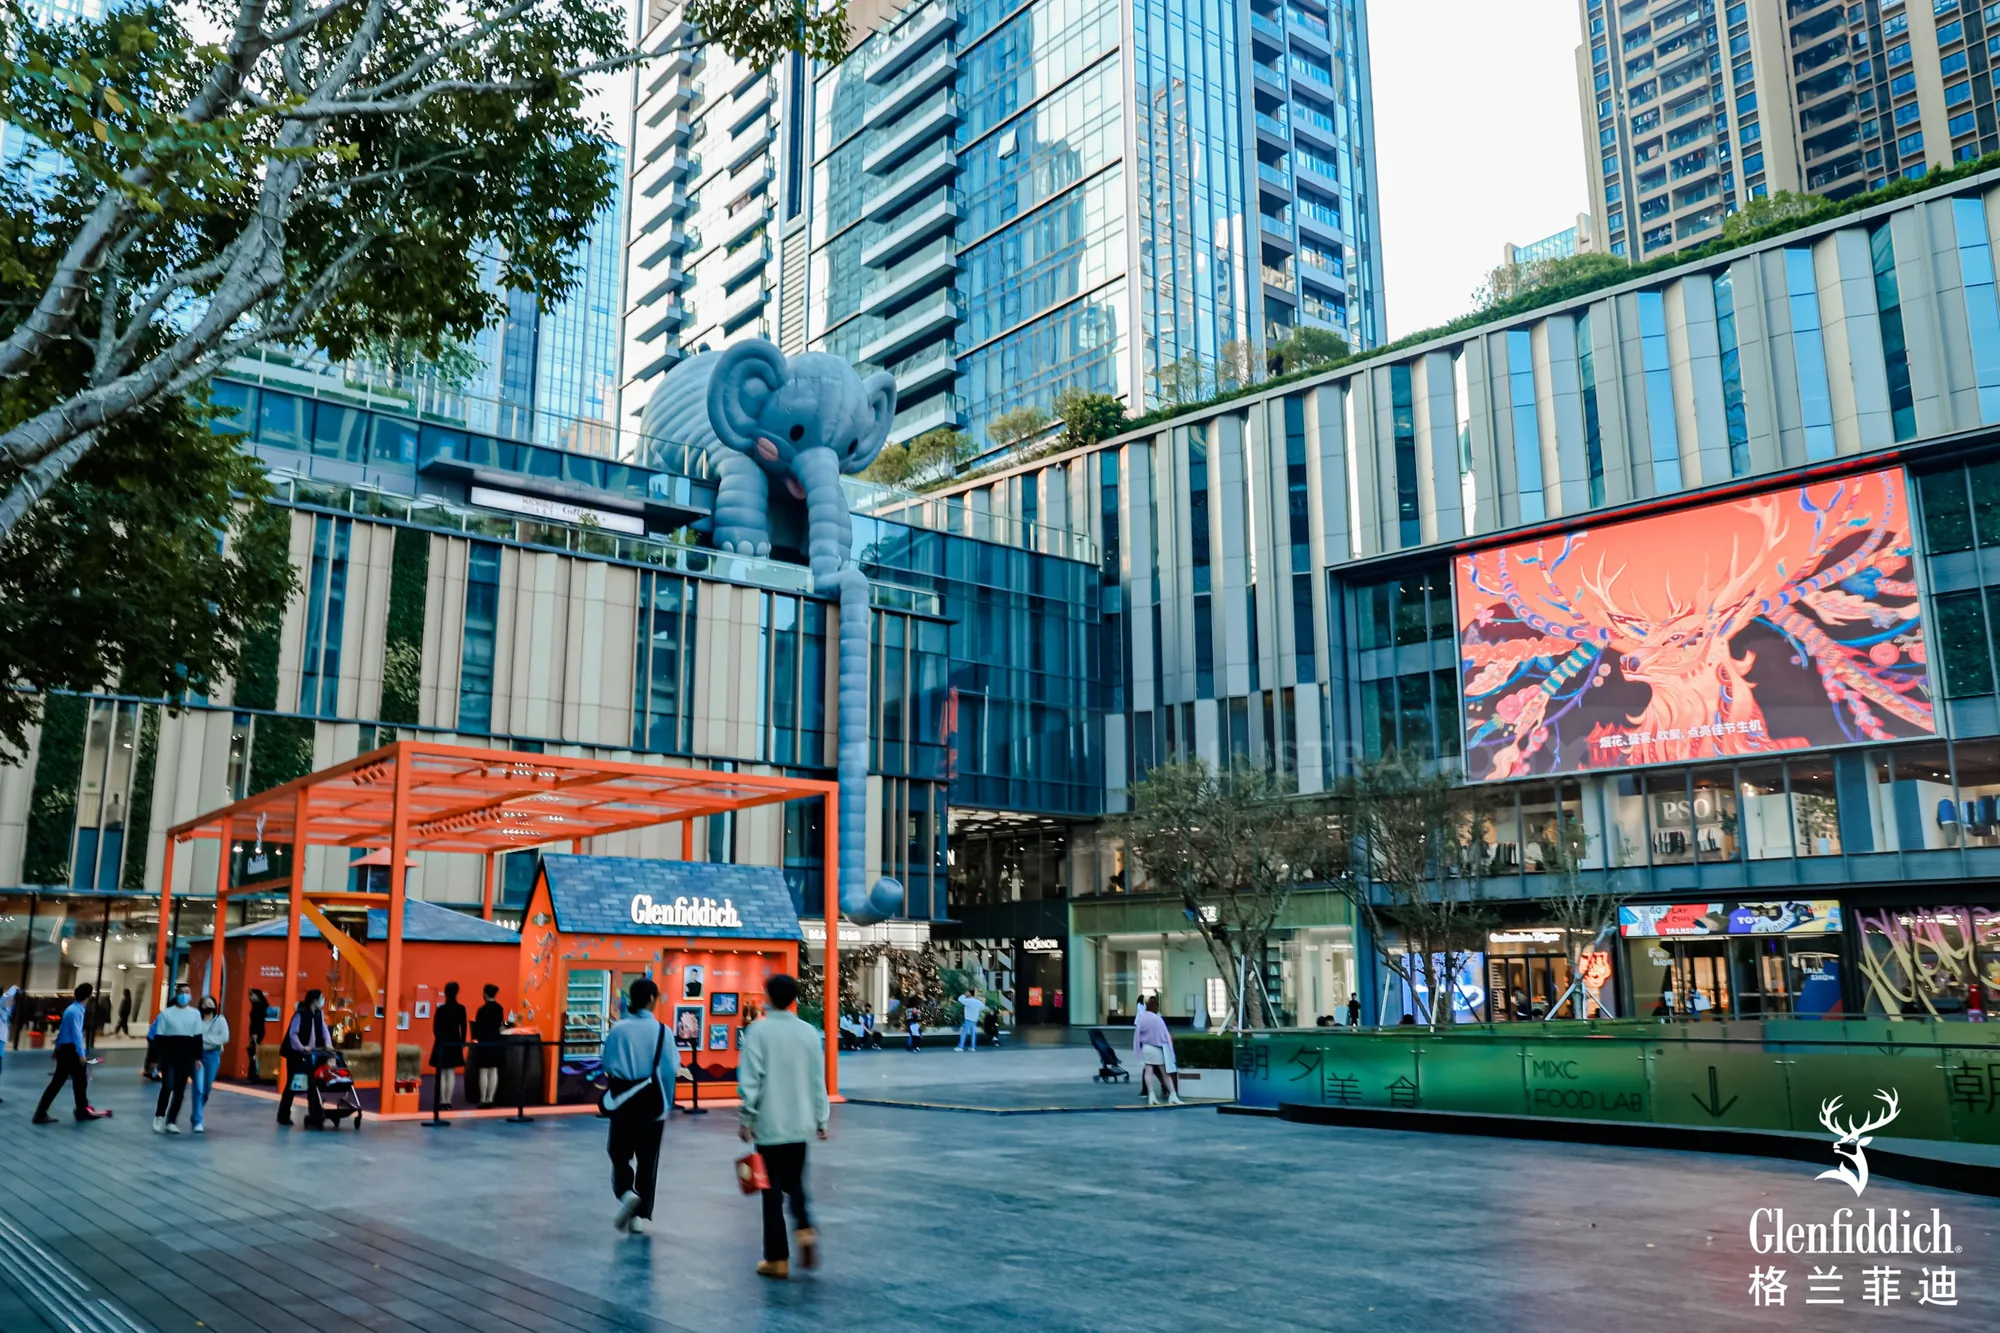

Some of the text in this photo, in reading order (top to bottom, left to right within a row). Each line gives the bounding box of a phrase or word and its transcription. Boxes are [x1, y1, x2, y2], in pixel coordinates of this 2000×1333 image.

[1661, 798, 1710, 821] PSO
[1737, 915, 1760, 925] TOY
[1532, 1060, 1579, 1080] MIXC
[1326, 1072, 1417, 1108] 美食
[1534, 1089, 1643, 1112] FOOD LAB
